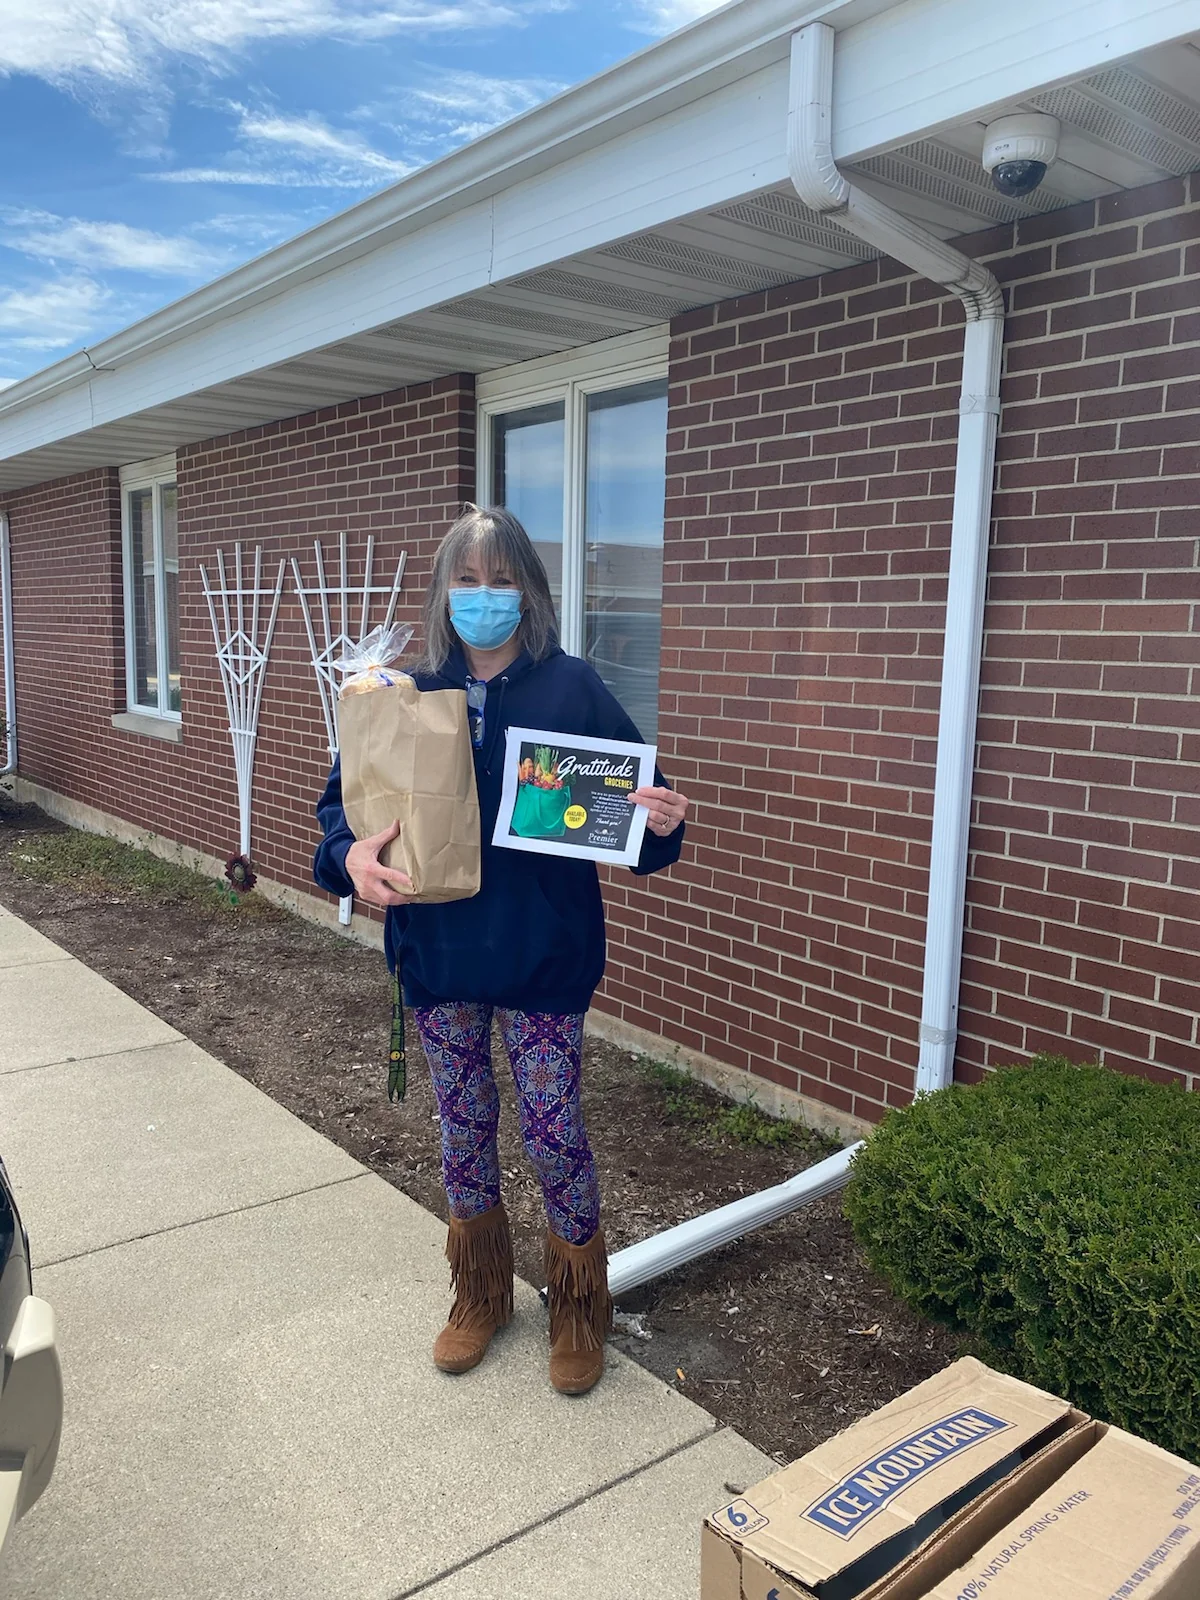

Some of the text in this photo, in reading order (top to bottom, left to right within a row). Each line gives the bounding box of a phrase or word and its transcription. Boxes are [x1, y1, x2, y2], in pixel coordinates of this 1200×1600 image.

[557, 755, 634, 780] Gratitude
[604, 777, 633, 789] GROCERIES
[588, 832, 618, 844] Premier
[816, 1414, 995, 1527] ICE MOUNTAIN
[1176, 1484, 1191, 1495] DO
[727, 1506, 748, 1527] 6
[1172, 1496, 1199, 1520] DOUBLE
[739, 1518, 765, 1533] GALLON
[980, 1540, 1026, 1581] NATURAL
[1020, 1512, 1059, 1542] SPRING
[1053, 1490, 1092, 1514] WATER
